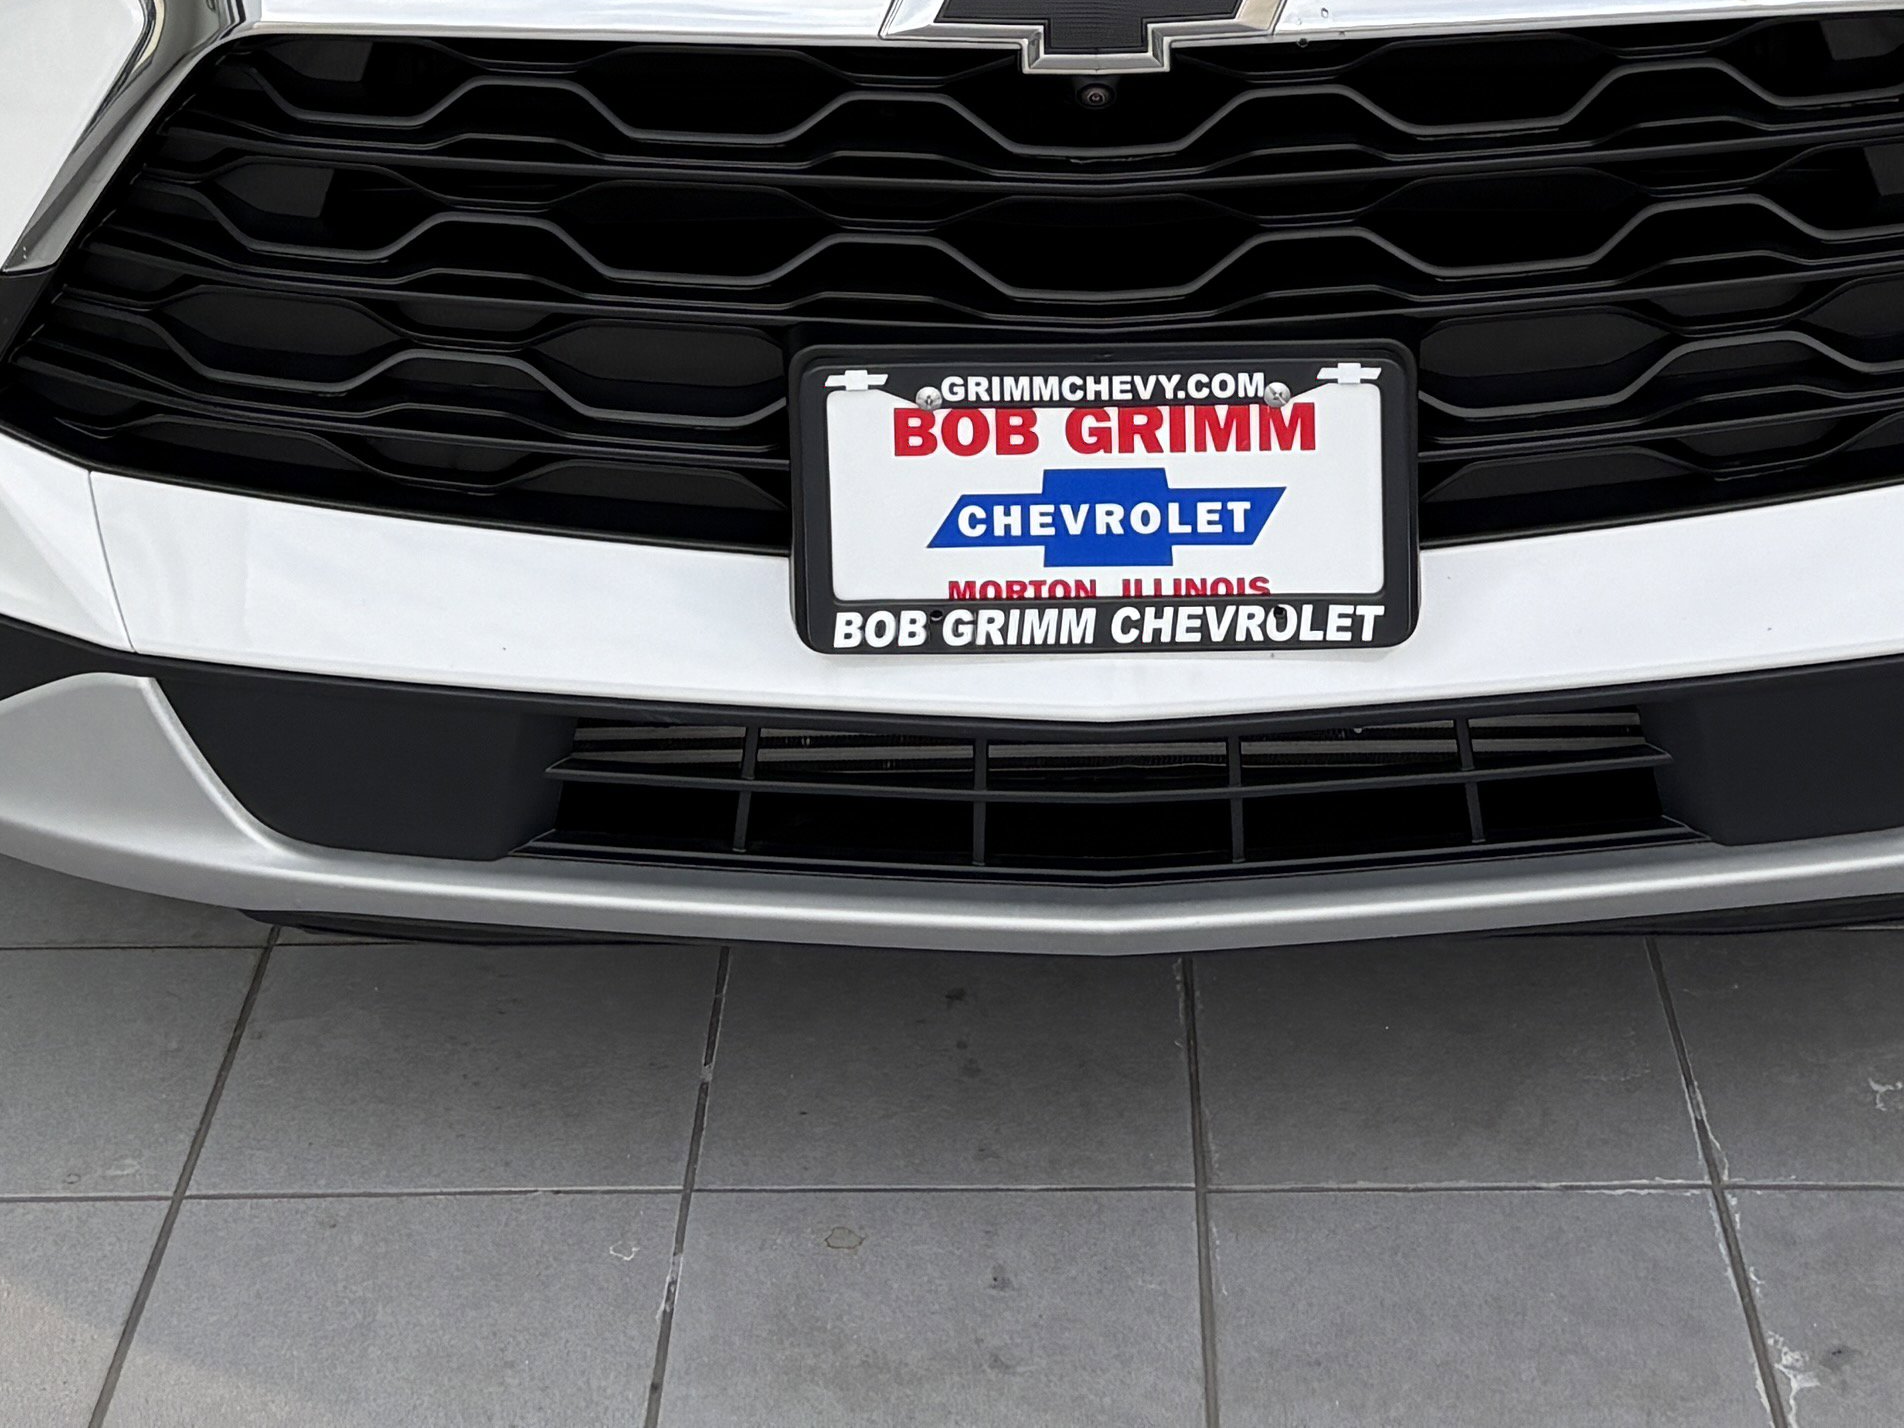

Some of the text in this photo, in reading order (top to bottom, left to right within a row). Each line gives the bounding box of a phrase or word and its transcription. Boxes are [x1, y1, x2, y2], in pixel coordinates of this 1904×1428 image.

[941, 372, 1265, 403] GRIMMCHEVY.COM
[894, 402, 1317, 458] BOB GRIMM
[957, 500, 1252, 538] CHEVROLET
[947, 576, 1271, 601] MORTON ILLINOIS
[833, 604, 1385, 648] BOB GRIMM CHEVROLET
